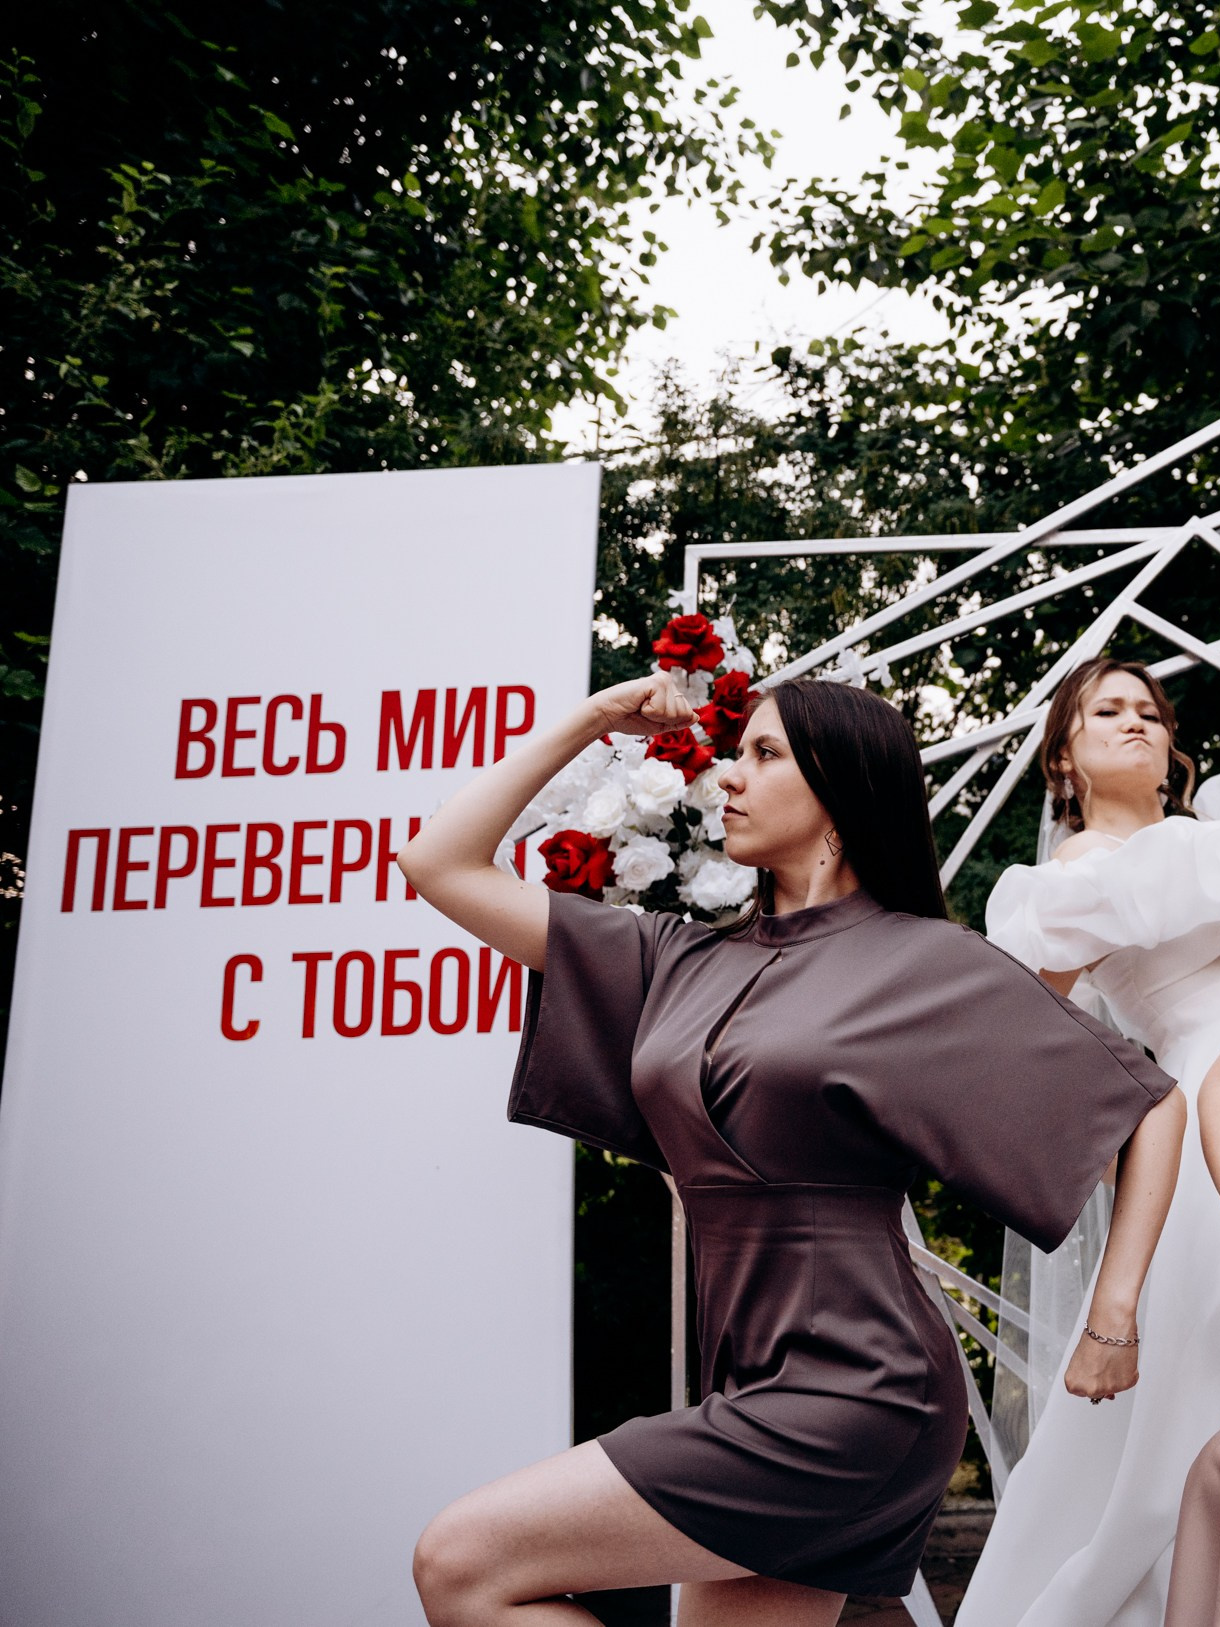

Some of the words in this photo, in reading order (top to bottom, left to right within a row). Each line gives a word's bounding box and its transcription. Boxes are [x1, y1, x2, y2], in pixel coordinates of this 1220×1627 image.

[175, 692, 347, 780] ВЕСЬ
[376, 684, 536, 772] МИР
[60, 816, 527, 913] ПЕРЕВЕРН
[220, 953, 264, 1042] С
